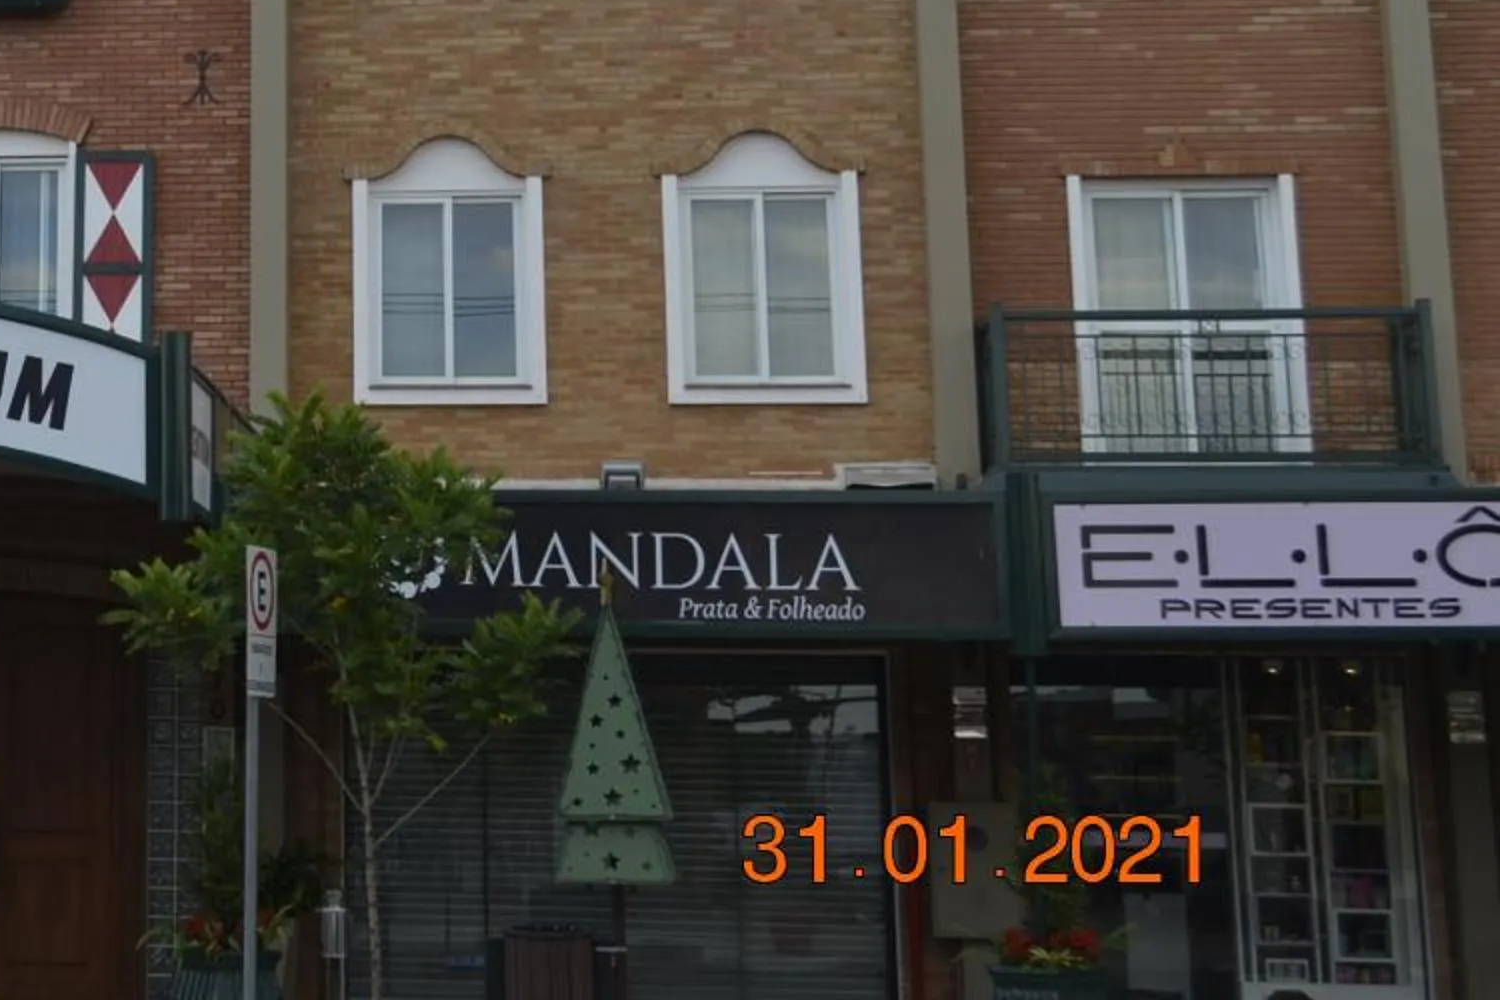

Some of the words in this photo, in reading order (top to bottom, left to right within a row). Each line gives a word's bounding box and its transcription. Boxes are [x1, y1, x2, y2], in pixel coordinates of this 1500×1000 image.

[460, 529, 862, 591] MANDALA
[678, 597, 738, 619] Prata
[743, 598, 761, 619] &
[766, 596, 866, 622] Folheado
[1161, 598, 1461, 619] PRESENTES
